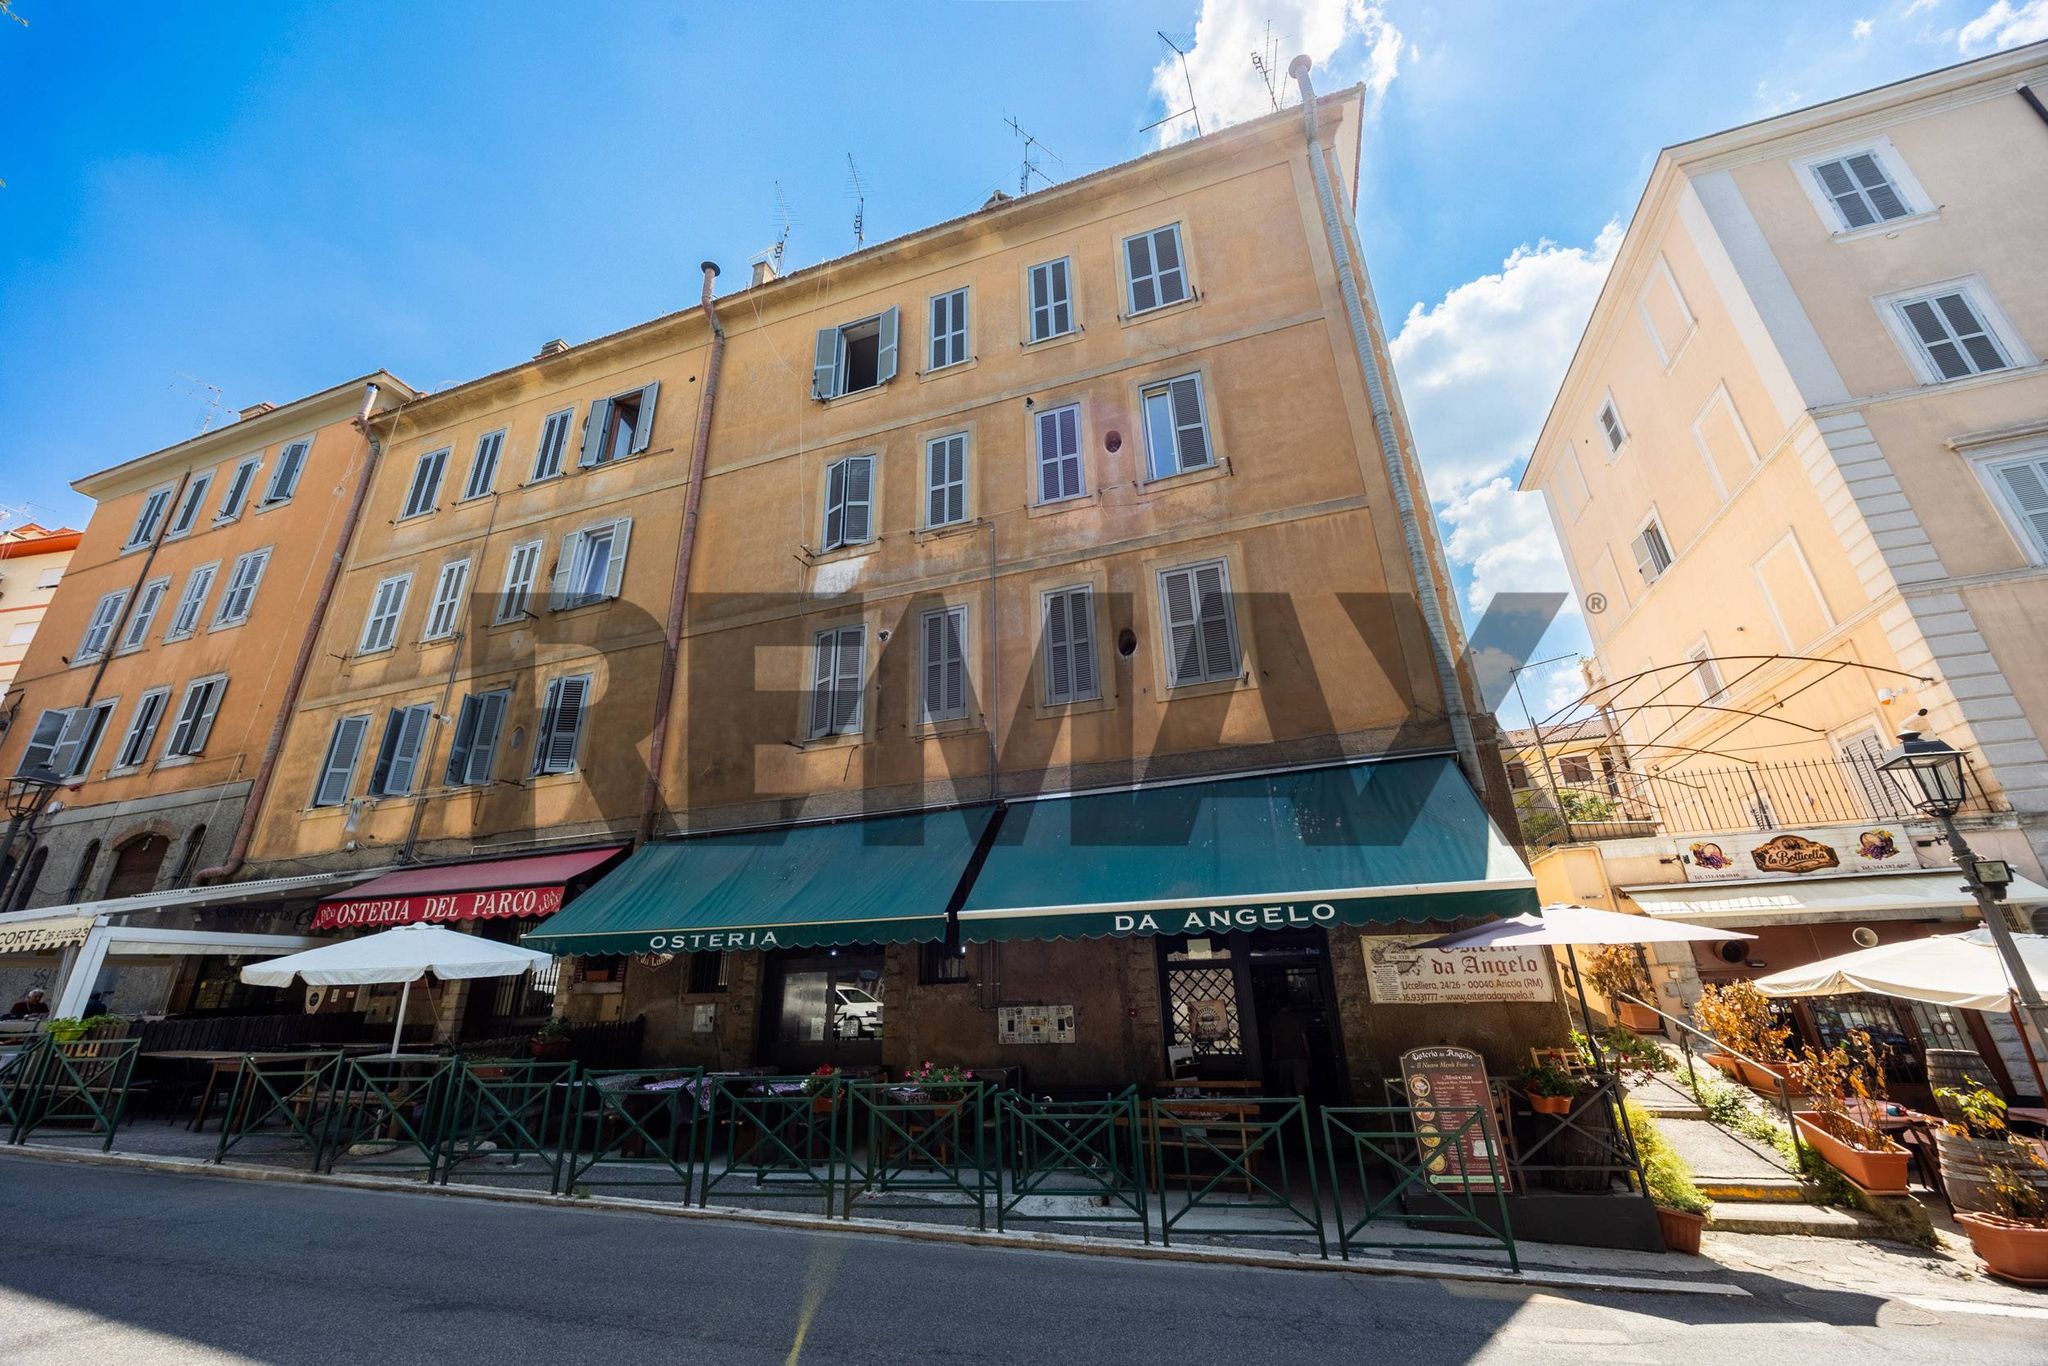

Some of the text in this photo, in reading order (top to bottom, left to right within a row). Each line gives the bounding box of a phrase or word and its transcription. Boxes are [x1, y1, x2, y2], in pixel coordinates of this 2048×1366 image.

[1776, 848, 1827, 866] Botticella
[337, 900, 410, 924] OSTERIA
[422, 896, 459, 919] DEL
[471, 890, 537, 915] PARCO
[1115, 903, 1336, 931] DA ANGELO
[650, 931, 777, 949] OSTERIA
[1431, 955, 1538, 977] da Angelo
[1468, 980, 1494, 989] 00040
[1496, 978, 1523, 989] Ariccia
[1523, 977, 1544, 990] (RM)
[1446, 1048, 1473, 1060] Angelo
